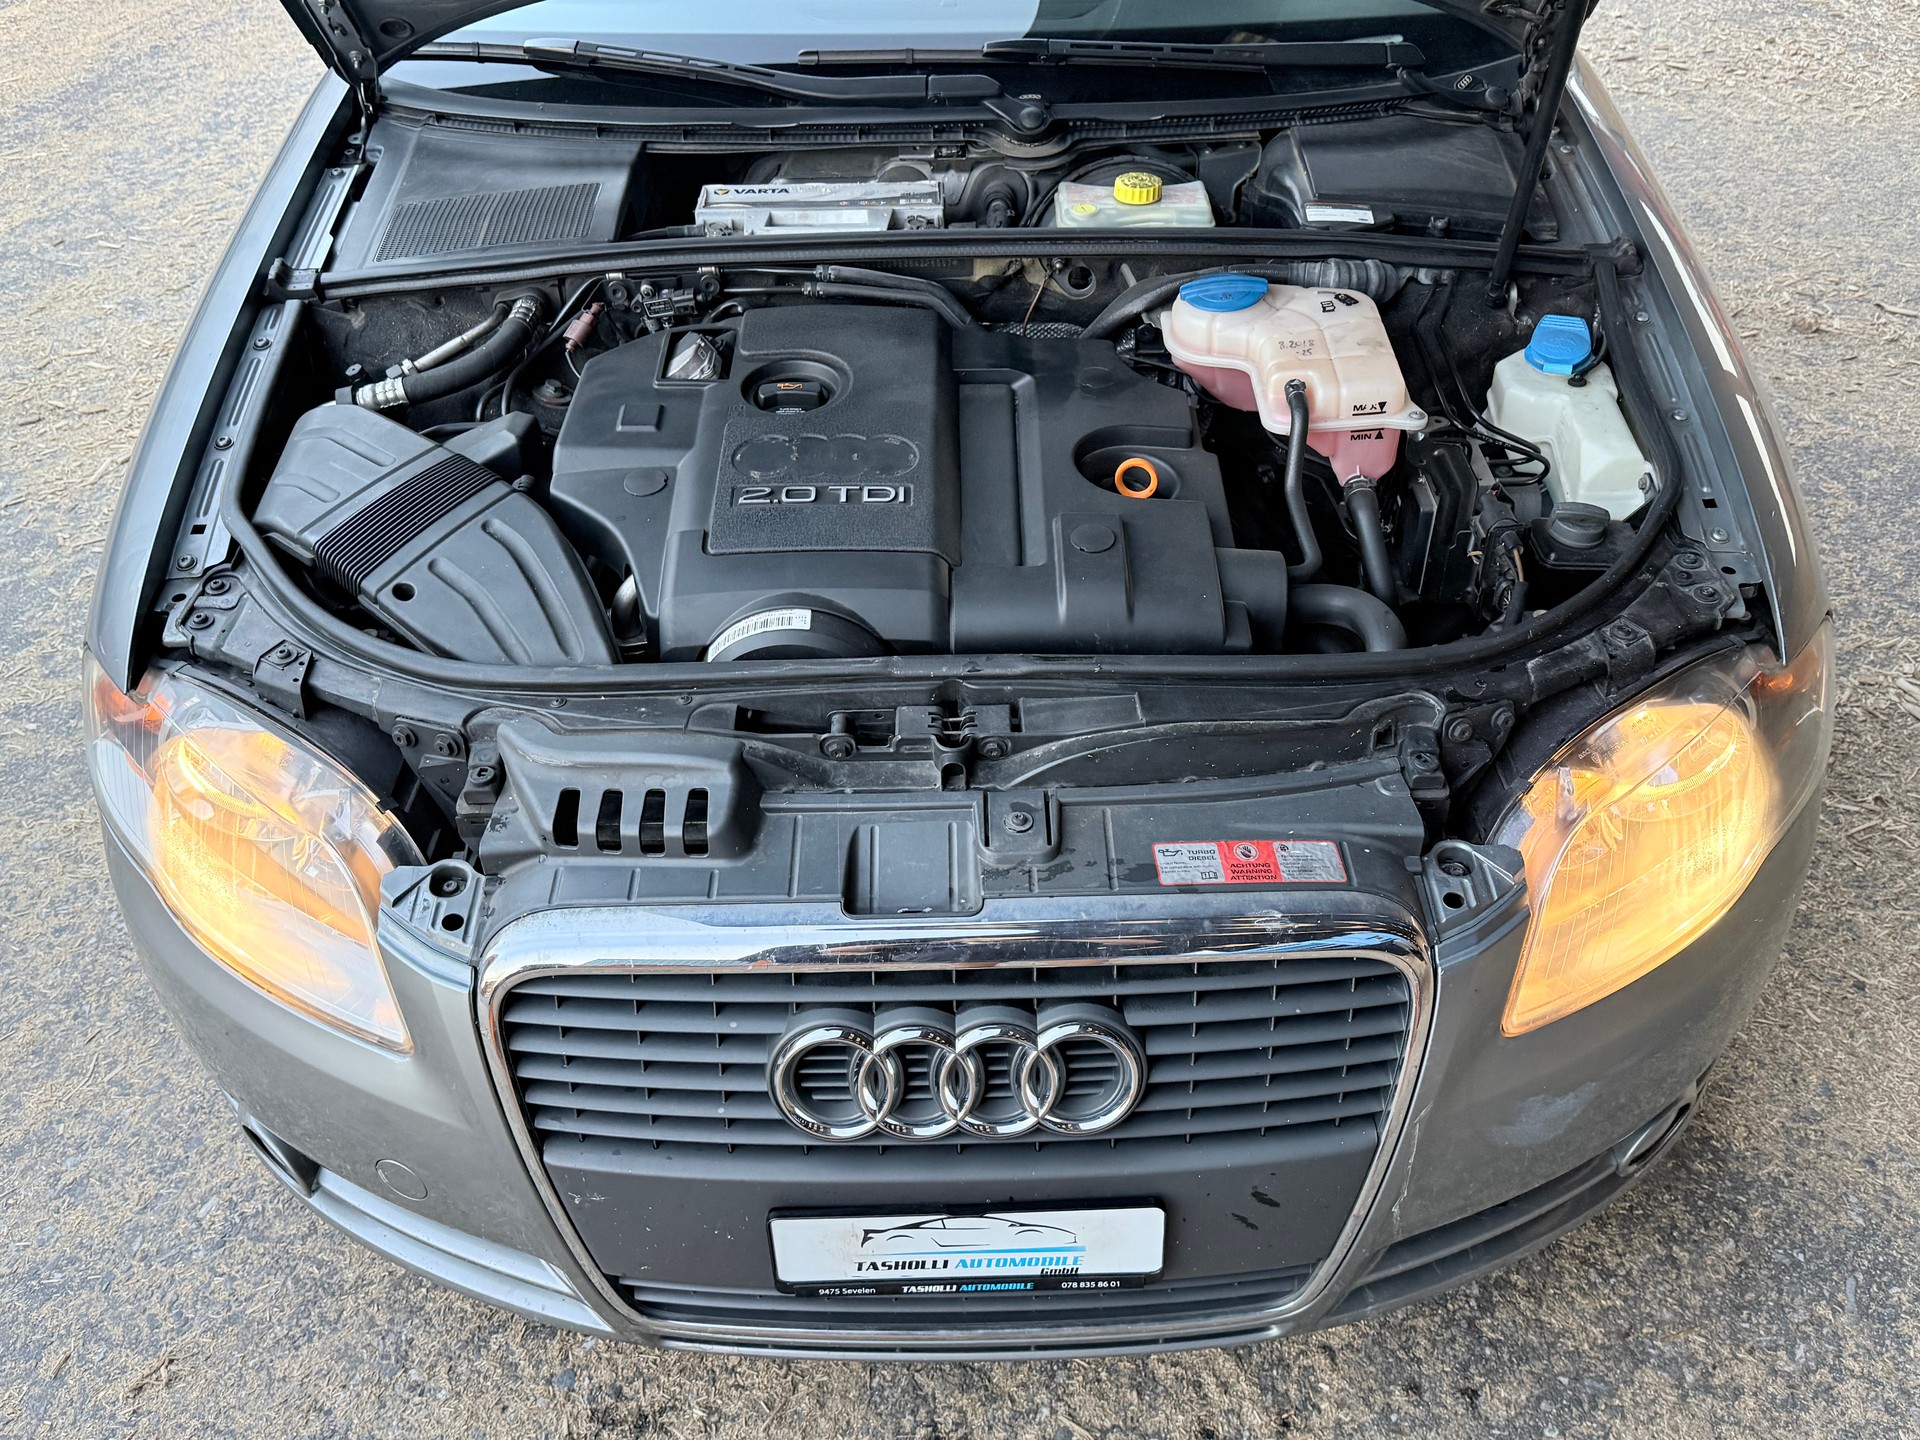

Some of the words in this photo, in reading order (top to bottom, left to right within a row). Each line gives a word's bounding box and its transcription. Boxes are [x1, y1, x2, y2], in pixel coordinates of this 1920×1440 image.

[1350, 433, 1372, 441] MIN
[738, 485, 817, 505] 2.0
[828, 485, 906, 504] TDI
[854, 1259, 949, 1272] TASHOLLI
[955, 1255, 1085, 1269] AUTOMOBILE
[1040, 1267, 1080, 1277] GmbH
[902, 1284, 957, 1293] TASHOLLI
[959, 1282, 1035, 1291] AUTOMOBILE
[1061, 1281, 1078, 1289] 078
[842, 1287, 876, 1295] Sevelen
